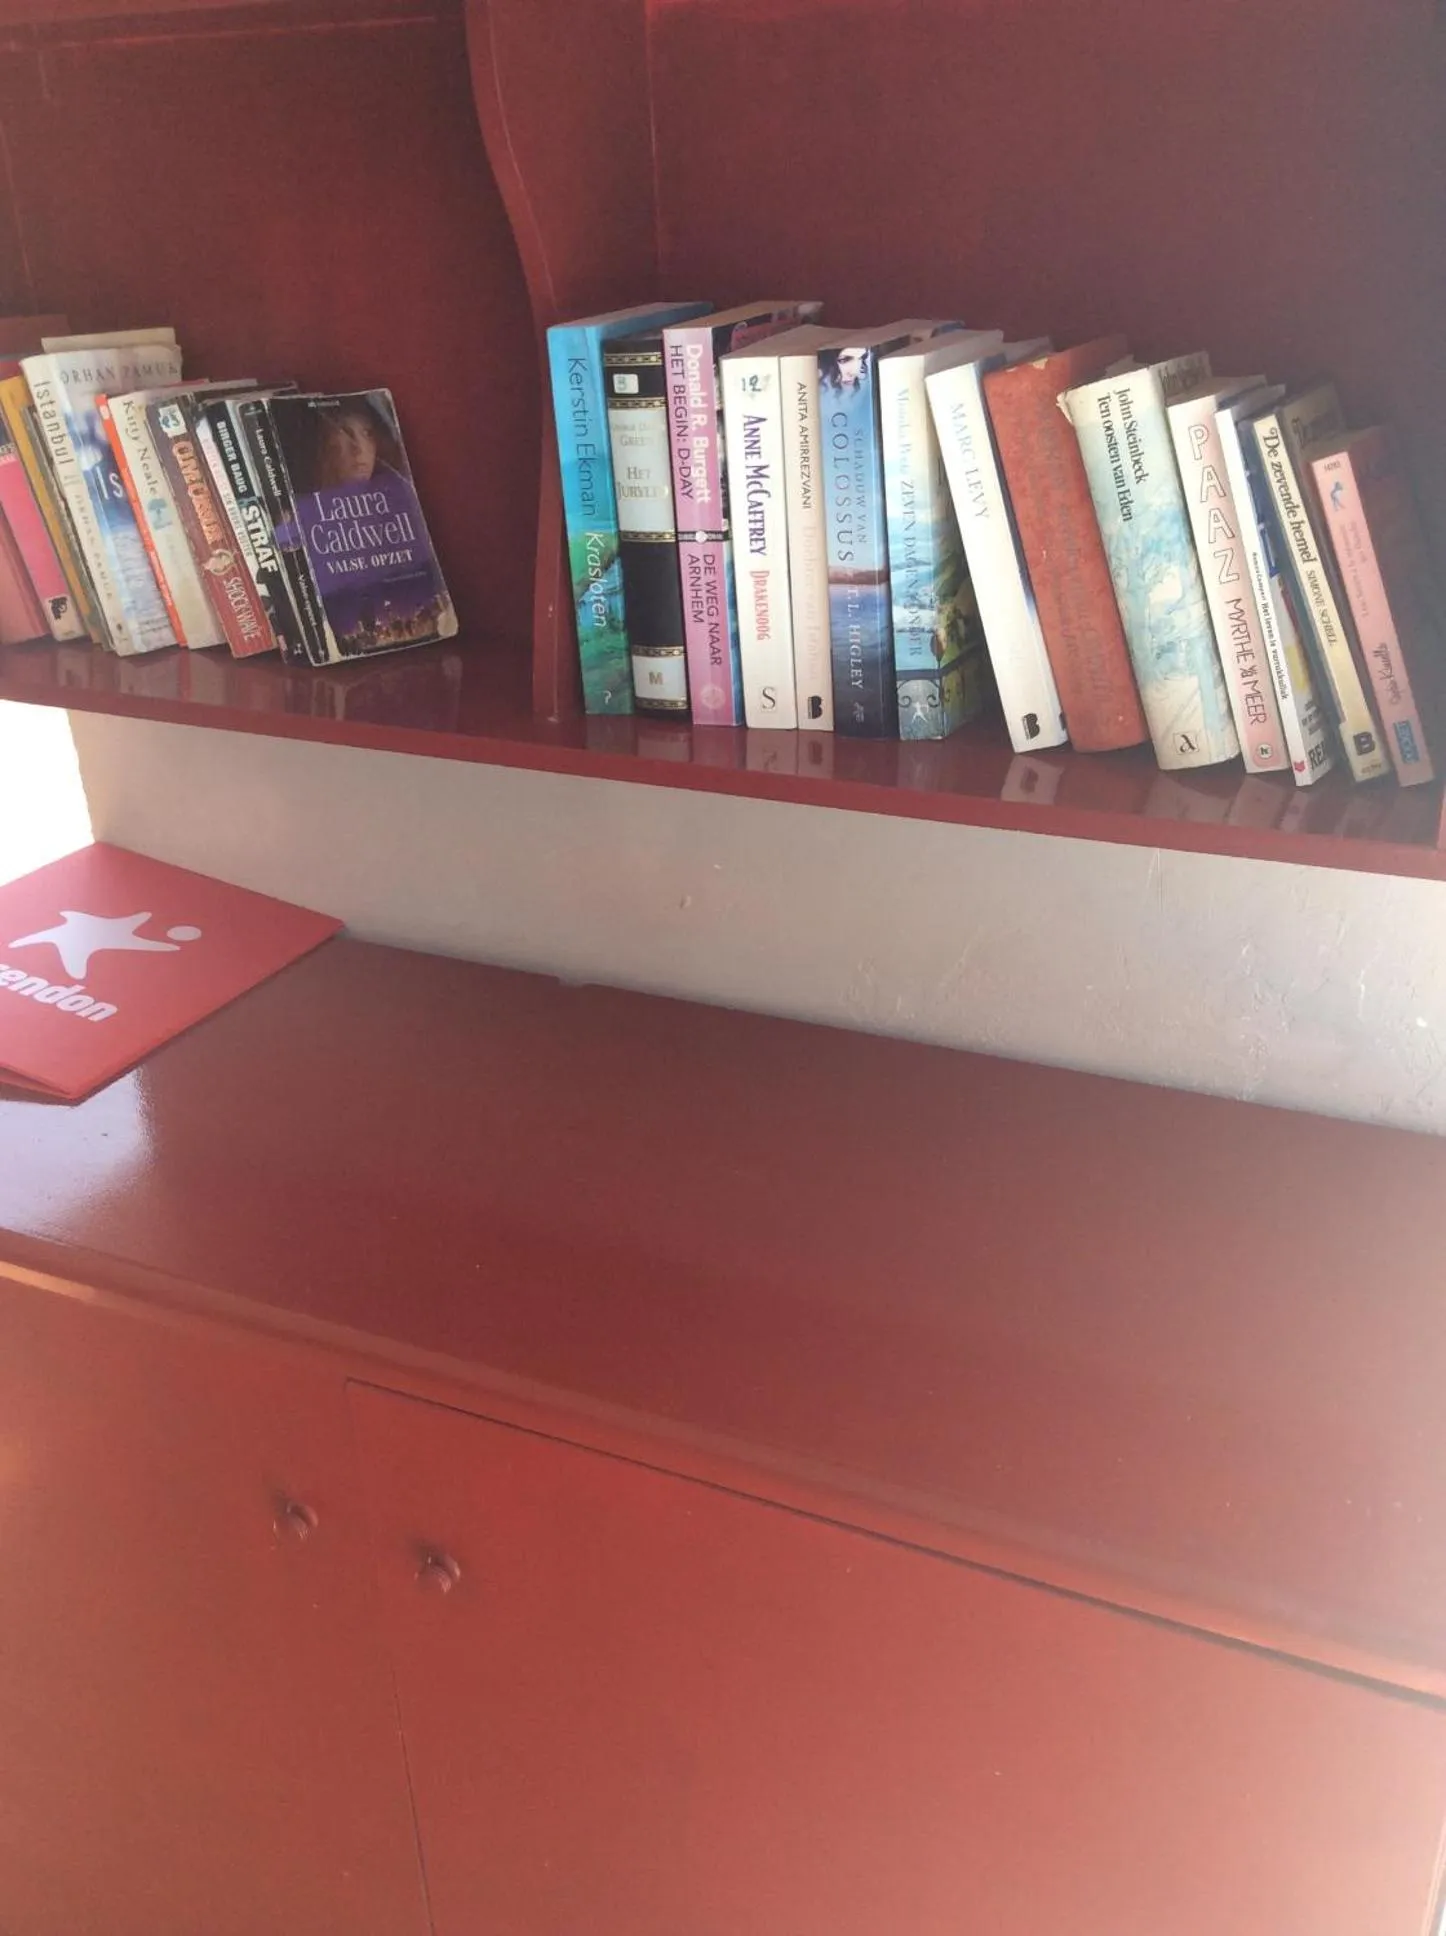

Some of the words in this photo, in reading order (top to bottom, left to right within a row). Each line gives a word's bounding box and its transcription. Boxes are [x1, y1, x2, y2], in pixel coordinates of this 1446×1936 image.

[60, 366, 115, 385] ORHAN
[122, 362, 178, 380] PAMUK
[669, 344, 685, 379] HET
[687, 344, 709, 411] Donald
[33, 380, 75, 465] Istanbul
[567, 357, 591, 438] Kerstin
[673, 384, 689, 442] BEGIN:
[692, 414, 708, 431] R.
[796, 381, 809, 423] ANITA
[1096, 391, 1110, 420] Ten
[1113, 387, 1132, 420] John
[122, 400, 141, 441] Kitty
[137, 447, 160, 495] Neale
[216, 420, 237, 462] BIRGER
[255, 428, 267, 455] Laura
[263, 455, 282, 498] Caldwell
[742, 414, 768, 461] ANNE
[951, 402, 976, 461] MARC
[964, 468, 990, 520] LEVY
[1101, 420, 1120, 465] oosten
[1121, 419, 1149, 486] Steinbeck
[576, 443, 597, 516] Ekman
[678, 448, 694, 500] D-DAY
[693, 437, 713, 504] Burgett
[799, 424, 814, 510] AMIRREZVANI
[831, 411, 856, 563] COLOSSUS
[853, 428, 867, 509] SCHADUW
[1112, 464, 1126, 490] van
[313, 490, 390, 522] Laura
[901, 479, 917, 534] ZEVEN
[1117, 489, 1134, 523] Eden
[1188, 423, 1241, 586] PAAZ
[1262, 426, 1279, 457] De
[1271, 460, 1299, 519] zevende
[1289, 519, 1319, 566] hemel
[241, 504, 279, 573] STRAF
[310, 512, 416, 555] Caldwell
[857, 513, 868, 544] VAN
[326, 556, 368, 575] VALSE
[370, 549, 413, 568] OPZET
[584, 531, 610, 628] Krasloten
[703, 553, 716, 577] DE
[904, 536, 919, 591] DAGEN
[1305, 568, 1326, 608] SIMONE
[687, 554, 705, 624] ARNHEM
[704, 580, 720, 617] WEG
[749, 569, 772, 642] DRAKENOOG
[1260, 602, 1271, 618] Het
[708, 622, 723, 666] NAAR
[1262, 617, 1275, 641] leven
[648, 671, 664, 686] M
[849, 624, 865, 690] HIGLEY
[1226, 598, 1255, 664] MYRTHE
[1241, 680, 1268, 726] MEER
